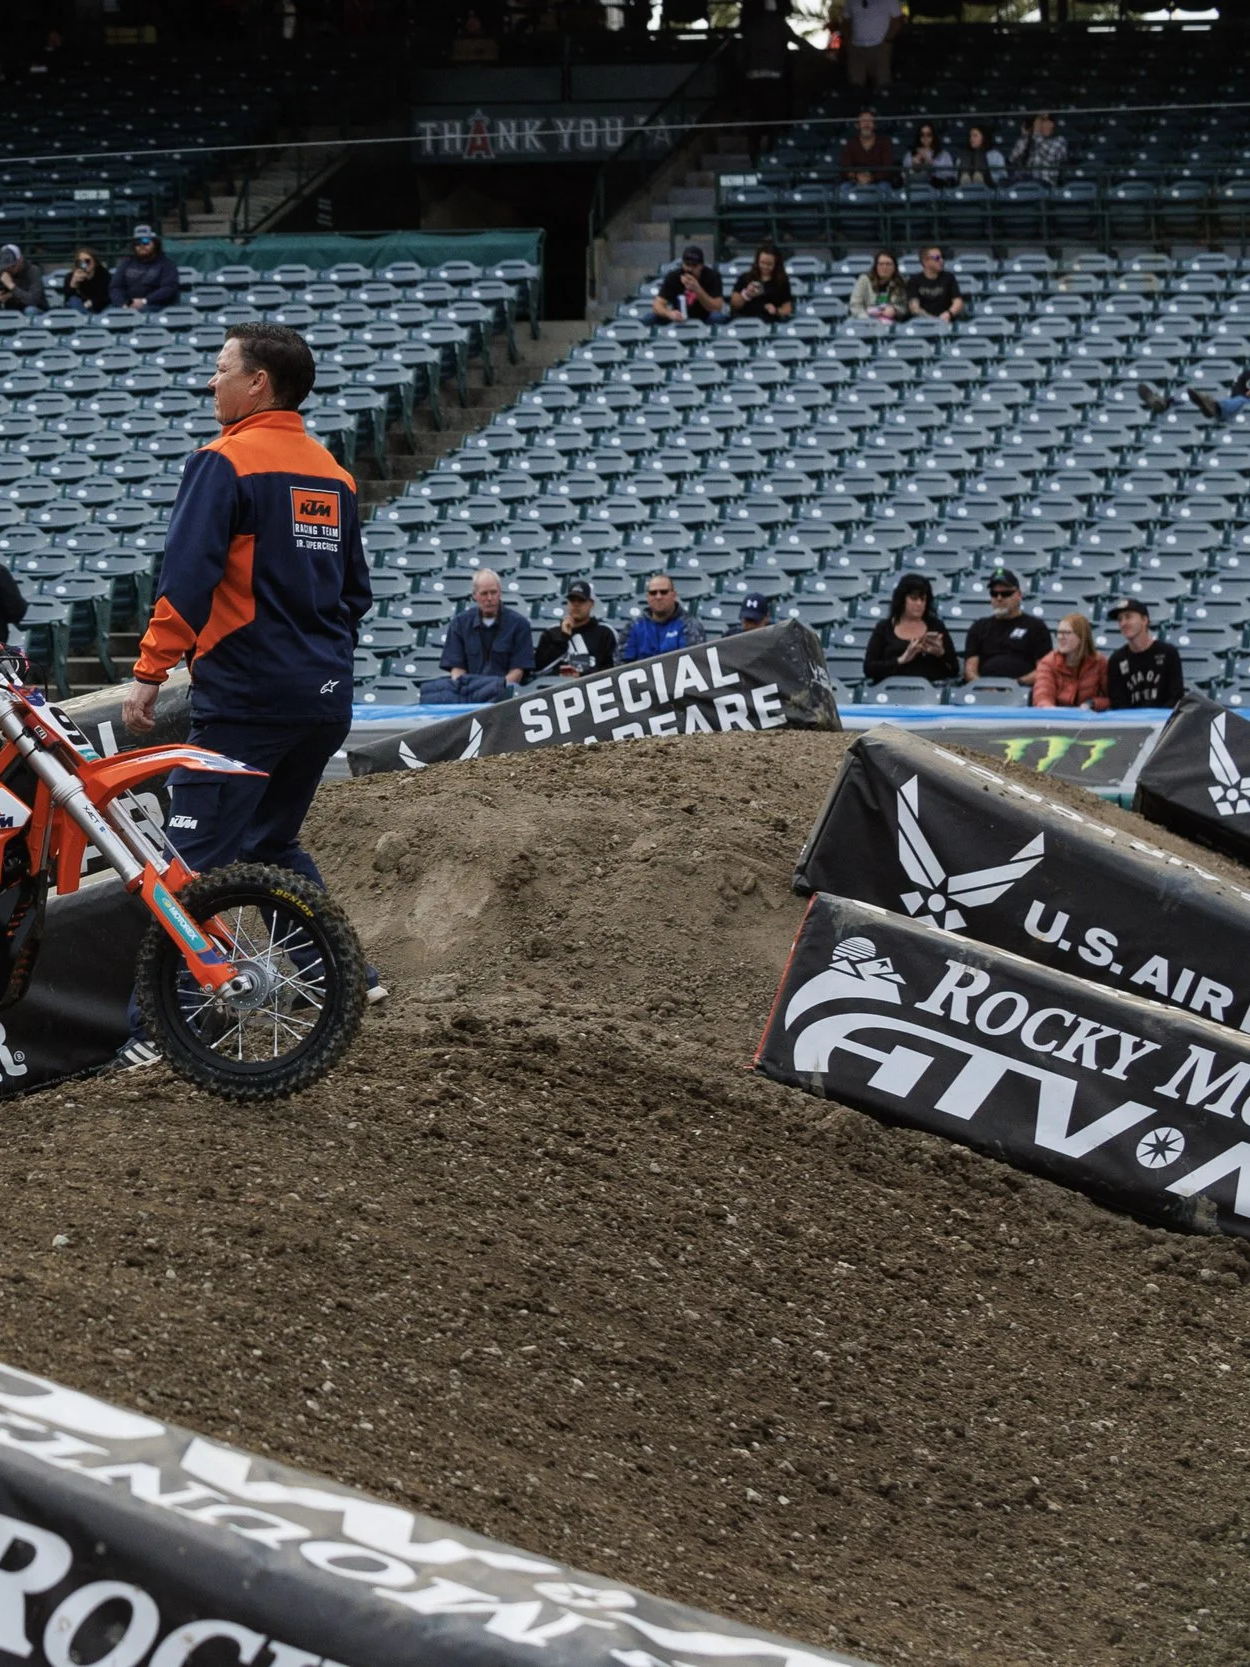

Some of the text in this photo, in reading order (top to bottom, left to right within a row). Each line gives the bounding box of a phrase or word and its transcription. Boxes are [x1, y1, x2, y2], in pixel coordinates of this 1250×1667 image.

[417, 109, 546, 159] THANK
[555, 117, 625, 148] YOU
[300, 499, 331, 517] KTM
[295, 523, 338, 538] RACING TEAM
[519, 646, 741, 743] SPECIAL
[169, 815, 198, 829] KTM
[270, 888, 315, 917] DUNLOP
[168, 906, 199, 941] MOTOREX
[1024, 899, 1123, 975] U.S.
[1130, 955, 1234, 1022] AIR
[914, 959, 1161, 1080] ROCKY
